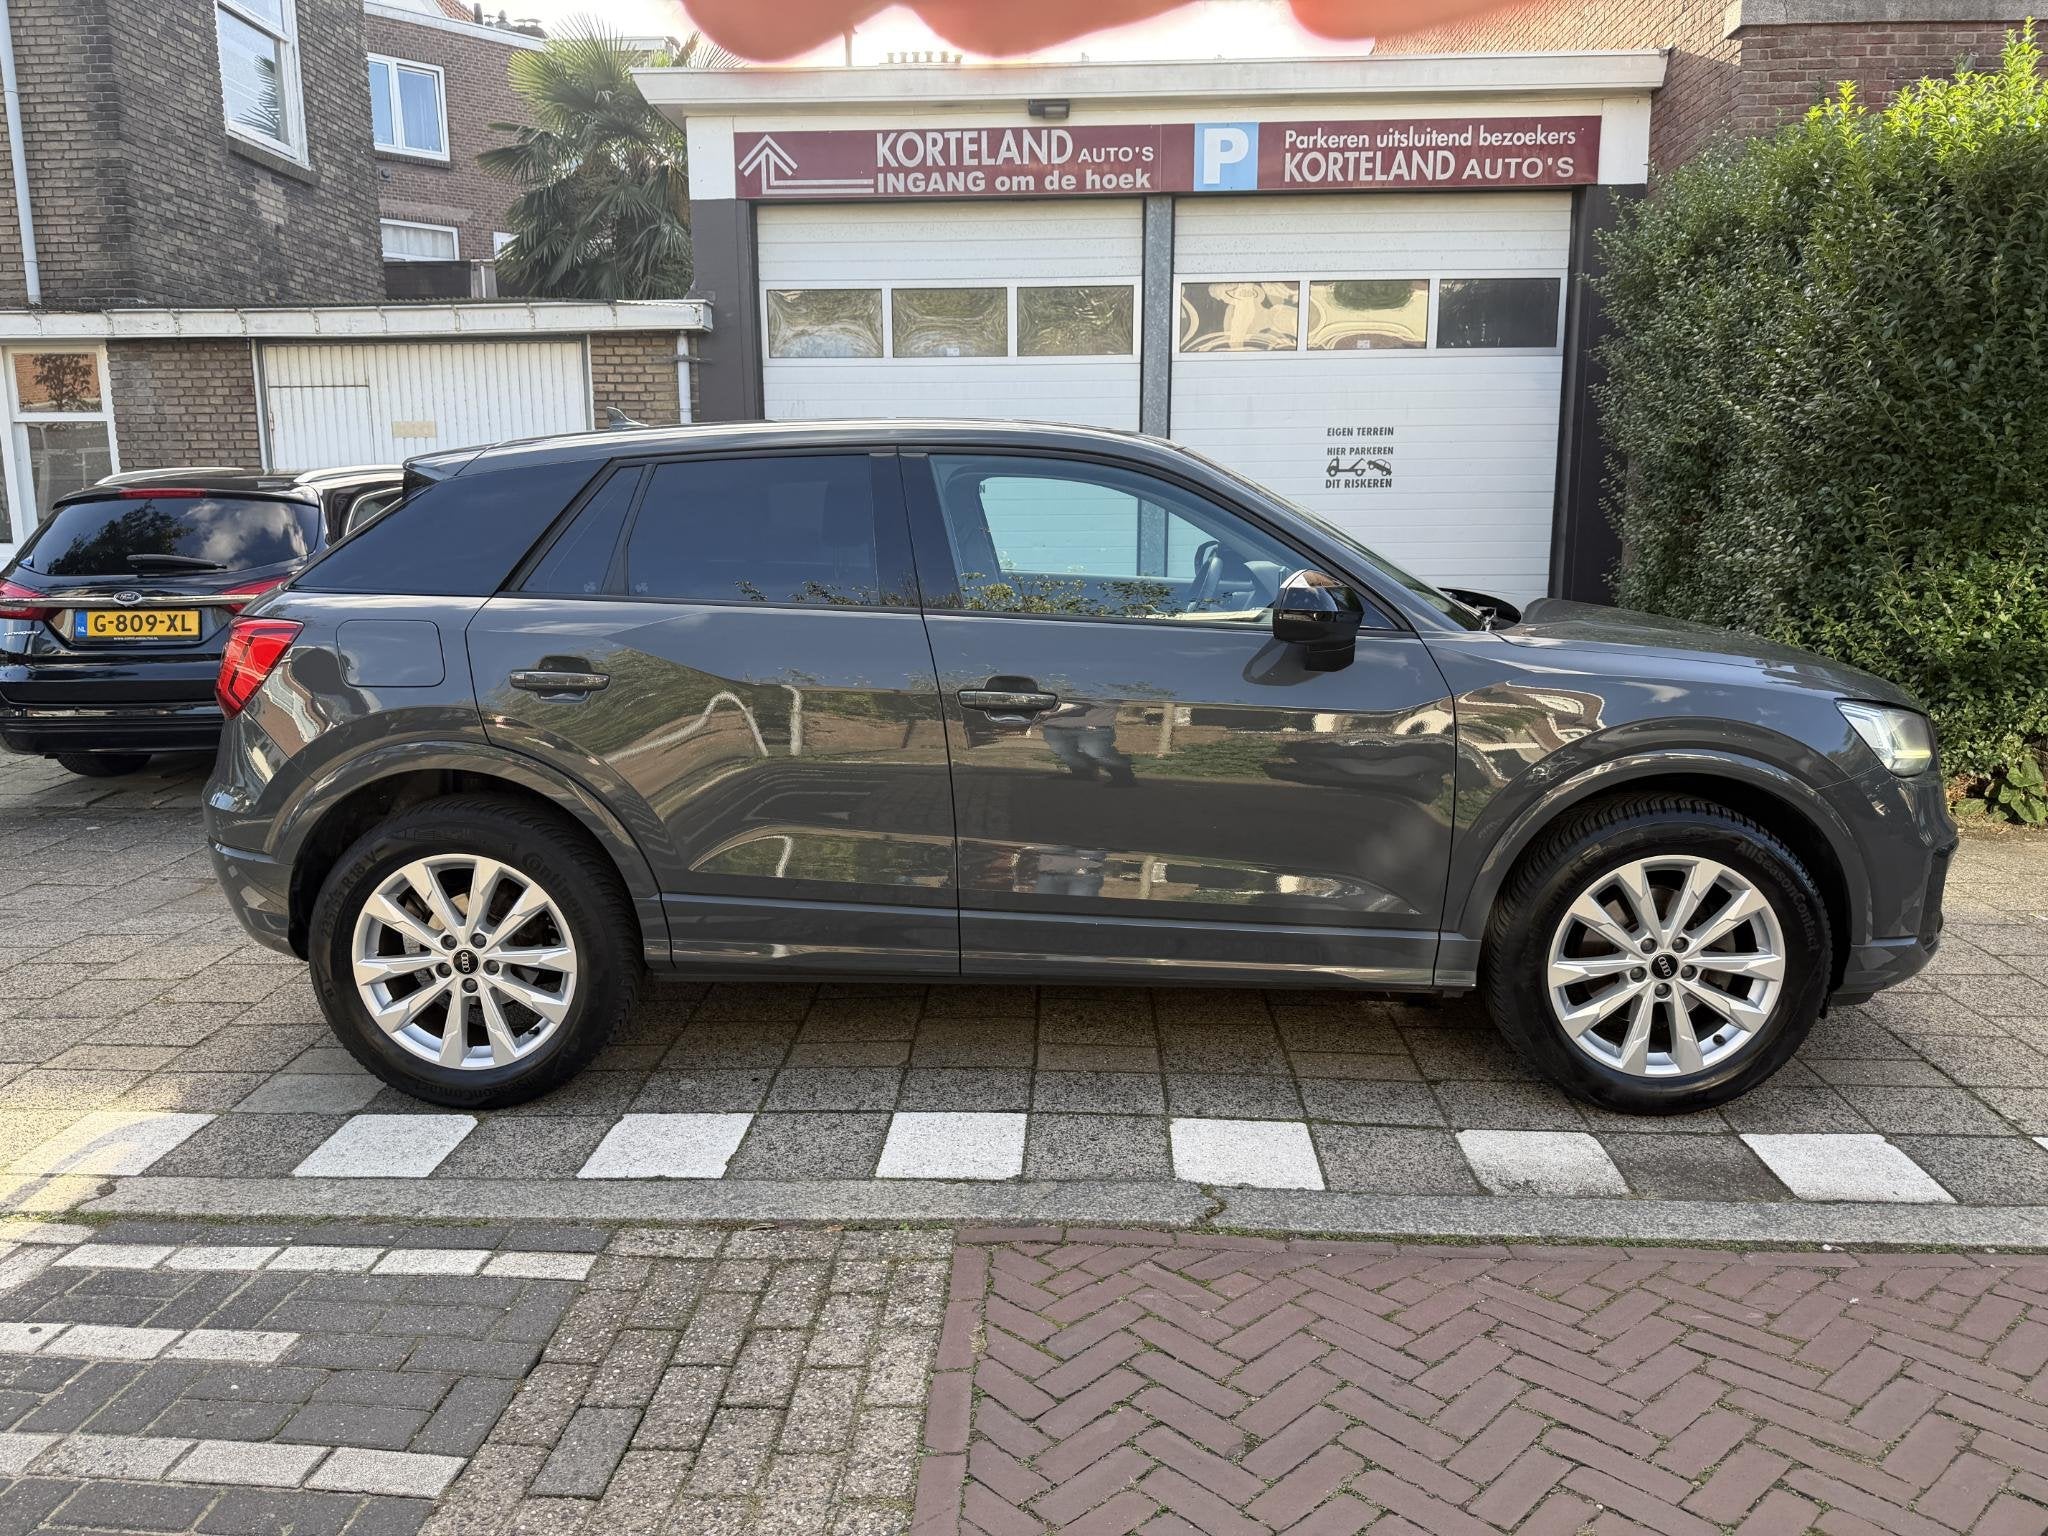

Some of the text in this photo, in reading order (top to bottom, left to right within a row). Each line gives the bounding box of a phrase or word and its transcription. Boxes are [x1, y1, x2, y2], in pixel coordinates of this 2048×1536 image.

[876, 128, 1154, 168] KORTELAND AUTO'S
[1284, 124, 1576, 150] Parkeren uitsluitend bezoekers
[1202, 127, 1249, 185] P
[1284, 150, 1575, 183] KORTELAND AUTO'S
[877, 168, 1154, 194] INGANG om de hoek
[1327, 427, 1394, 437] EIGEN TERREIN
[1327, 446, 1394, 456] HIER PARKEREN
[1325, 478, 1393, 489] DIT RISKEREN
[93, 614, 193, 633] G-809-XL
[1735, 839, 1820, 953] AllSeasonContact
